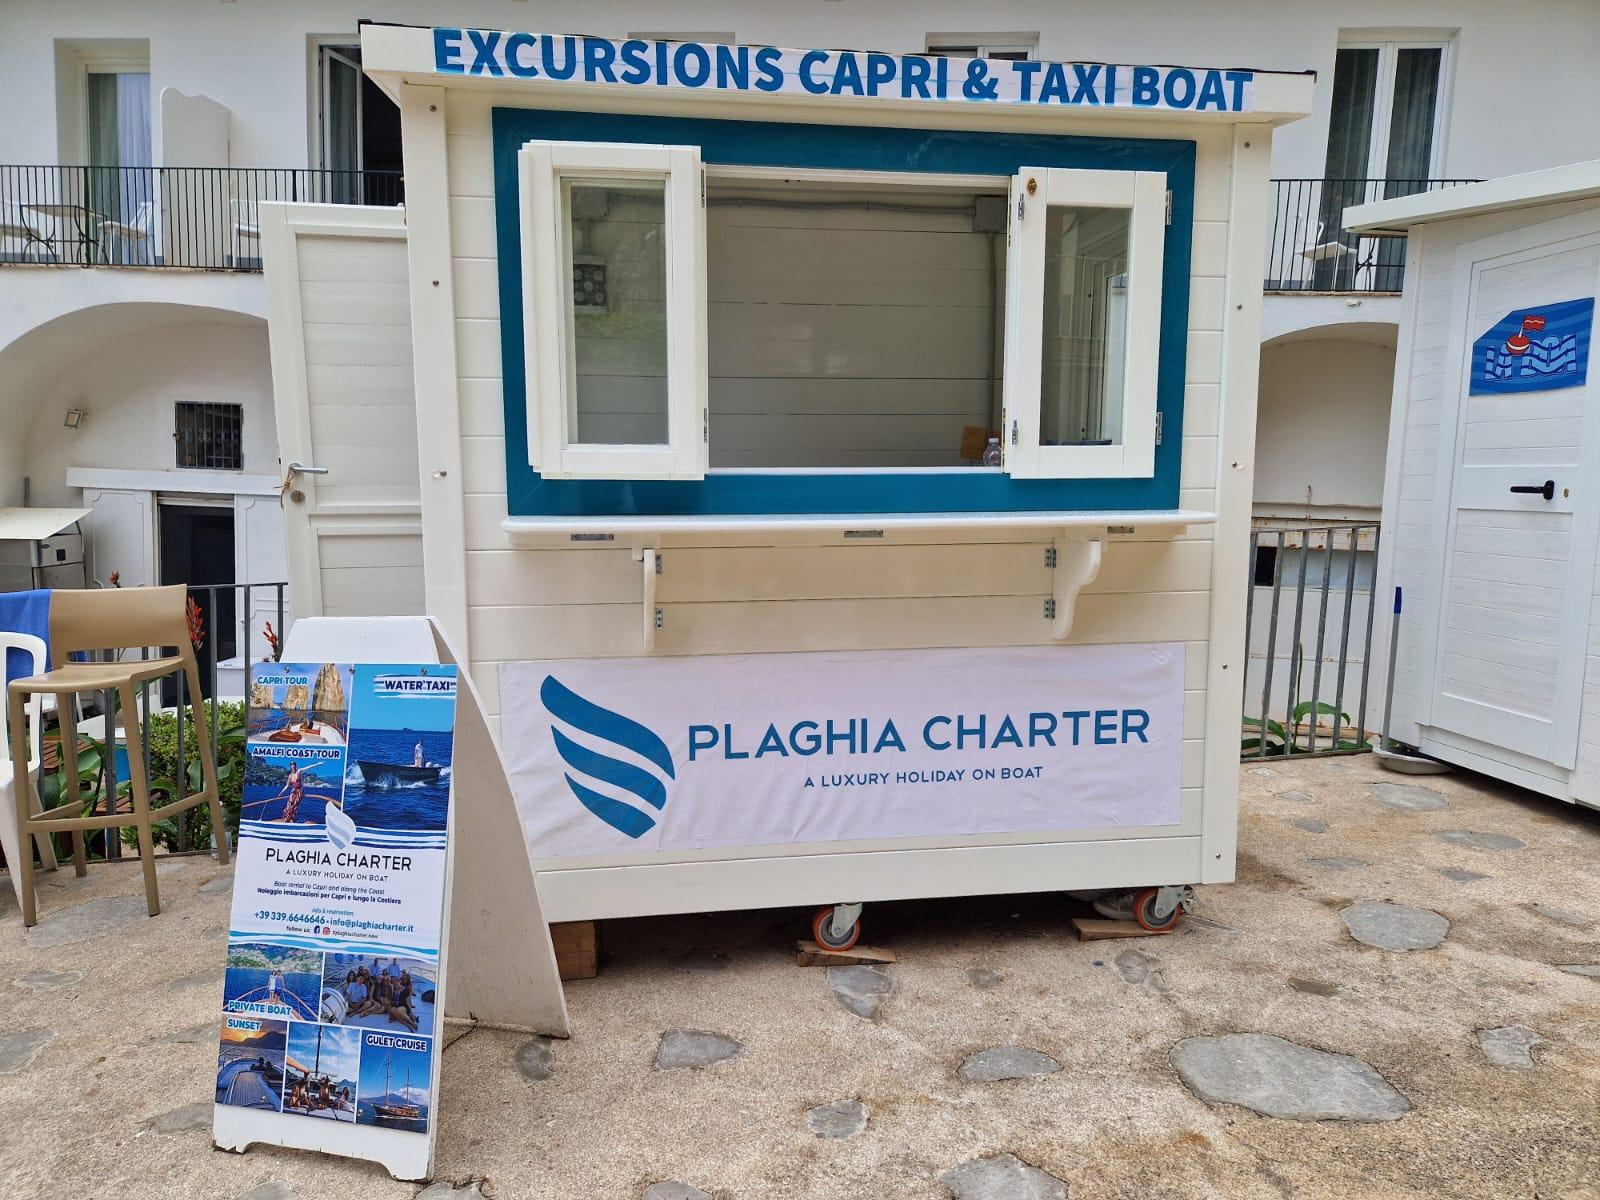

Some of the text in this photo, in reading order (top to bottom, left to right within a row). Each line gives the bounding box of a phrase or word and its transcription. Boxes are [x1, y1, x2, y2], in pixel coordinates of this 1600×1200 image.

[432, 27, 1254, 112] EXCURSIONS CAPRI & TAXI BOAT
[257, 675, 308, 686] CAPRI TOUR
[384, 679, 451, 691] WATER TAXI
[688, 708, 1151, 762] PLAGHIA CHARTER
[252, 747, 340, 759] AMALFI COAST TOUR
[803, 766, 1044, 788] A LUXURY HOLIDAY ON BOAT
[265, 847, 412, 872] PLAGHIA CHARTER
[293, 869, 322, 878] LUXURY
[324, 871, 354, 880] HOLIDAY
[356, 873, 368, 881] ON
[369, 874, 389, 882] BOAT
[257, 887, 283, 896] Noleggio
[283, 888, 320, 898] imbarcazioni
[320, 892, 331, 900] per
[331, 892, 347, 901] Capri
[352, 894, 370, 903] lungo
[377, 896, 402, 904] Costiera
[312, 883, 327, 891] Capri
[340, 885, 357, 894] along
[358, 886, 369, 894] the
[369, 887, 385, 895] Coast
[254, 910, 414, 933] +39 339.6646646 info@plaghiacharter.it
[229, 1000, 292, 1015] PRIVATE BOAT
[227, 1018, 262, 1031] SUNSET
[366, 1034, 427, 1051] GULET CRUISE
